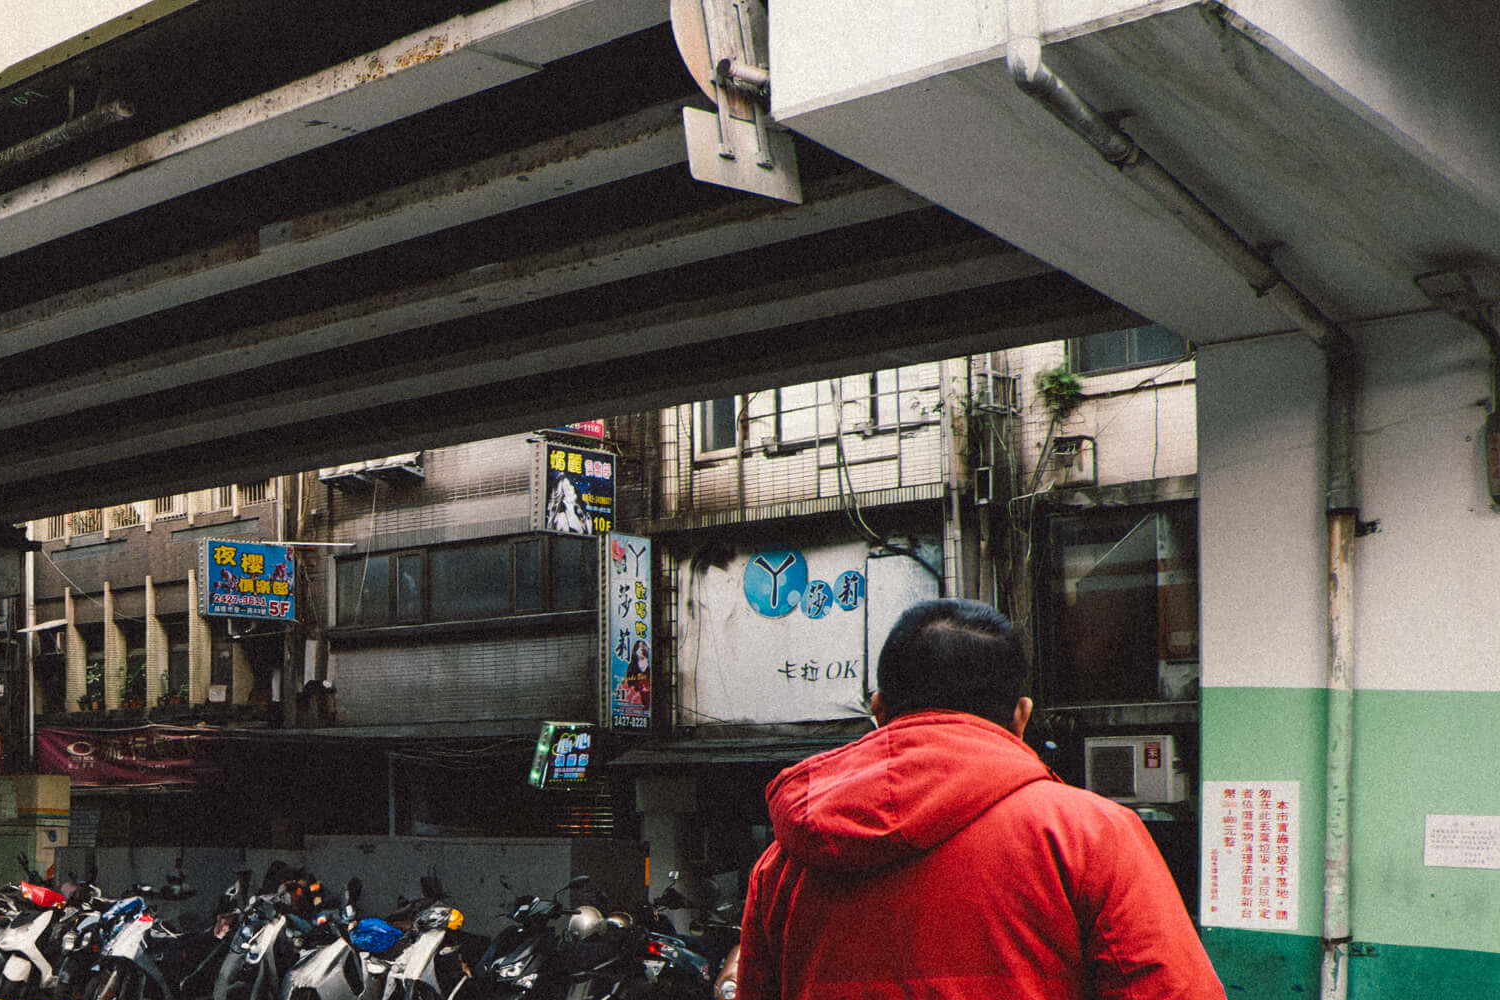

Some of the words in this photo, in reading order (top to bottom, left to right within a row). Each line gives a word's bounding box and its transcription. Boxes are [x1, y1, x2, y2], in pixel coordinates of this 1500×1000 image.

[594, 517, 612, 531] 10F
[213, 544, 265, 574] 夜櫻
[239, 578, 289, 596] 俱樂部
[268, 600, 291, 617] 5F
